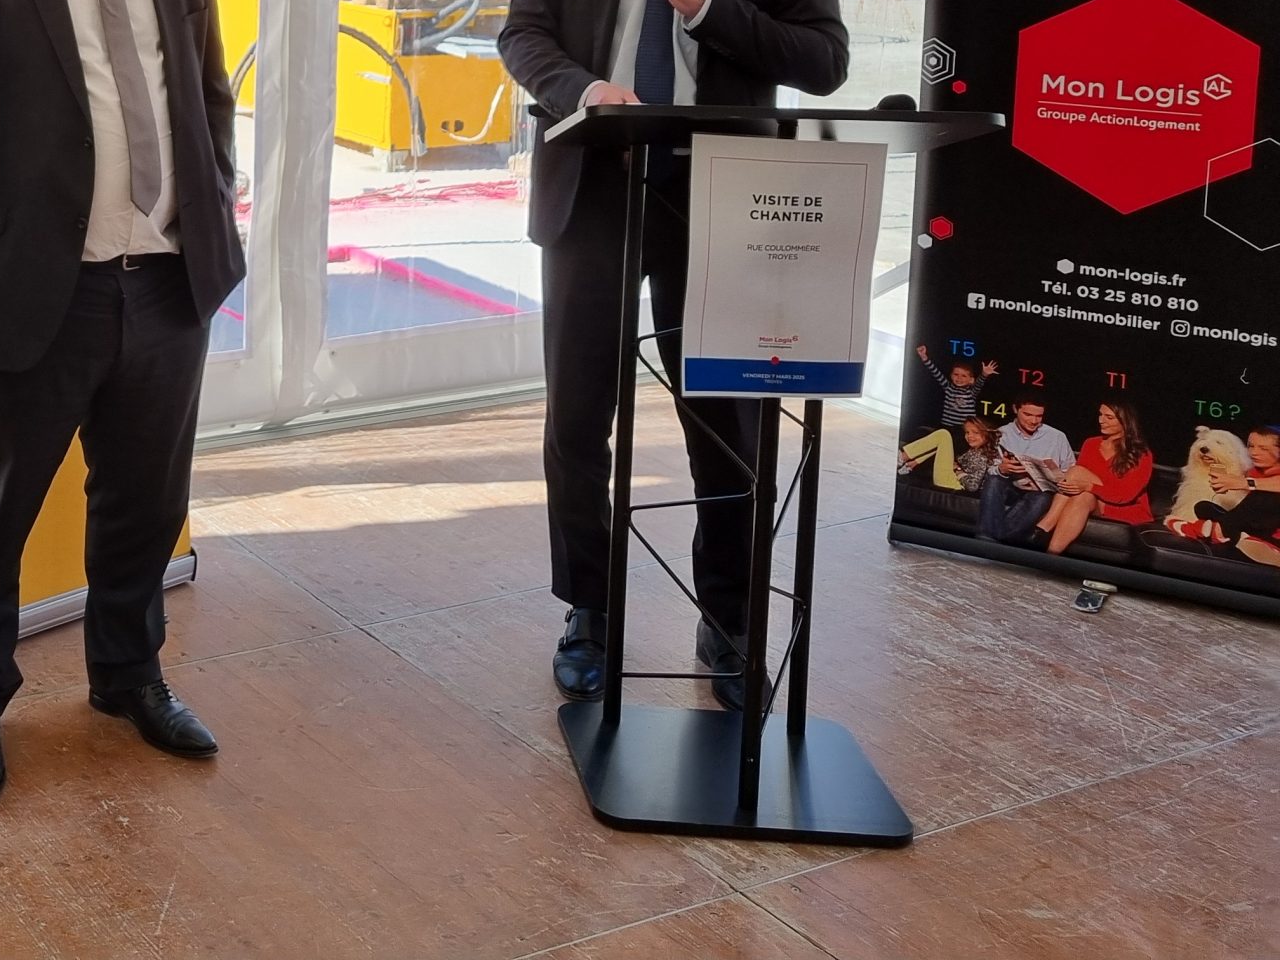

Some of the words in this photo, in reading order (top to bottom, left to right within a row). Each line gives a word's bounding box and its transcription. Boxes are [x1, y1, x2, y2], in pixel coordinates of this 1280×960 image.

[1041, 73, 1105, 99] Mon
[1116, 79, 1201, 108] Logis
[1036, 107, 1087, 124] Groupe
[1089, 111, 1201, 132] ActionLogement
[752, 193, 800, 207] VISITE
[804, 196, 823, 207] DE
[749, 209, 824, 223] CHANTIER
[746, 243, 763, 252] RUE
[768, 253, 799, 261] TROYES
[1079, 263, 1187, 287] mon-logis.fr
[1041, 280, 1072, 296] Tél.
[1076, 285, 1100, 300] 03
[1104, 289, 1126, 303] 25
[1130, 292, 1163, 308] 810
[1167, 296, 1199, 312] 810
[989, 296, 1161, 331] monlogisimmobilier
[1193, 323, 1278, 347] monlogis
[949, 339, 975, 357] T5
[1018, 368, 1044, 386] T2
[1105, 372, 1128, 389] T1
[980, 401, 1007, 419] T4
